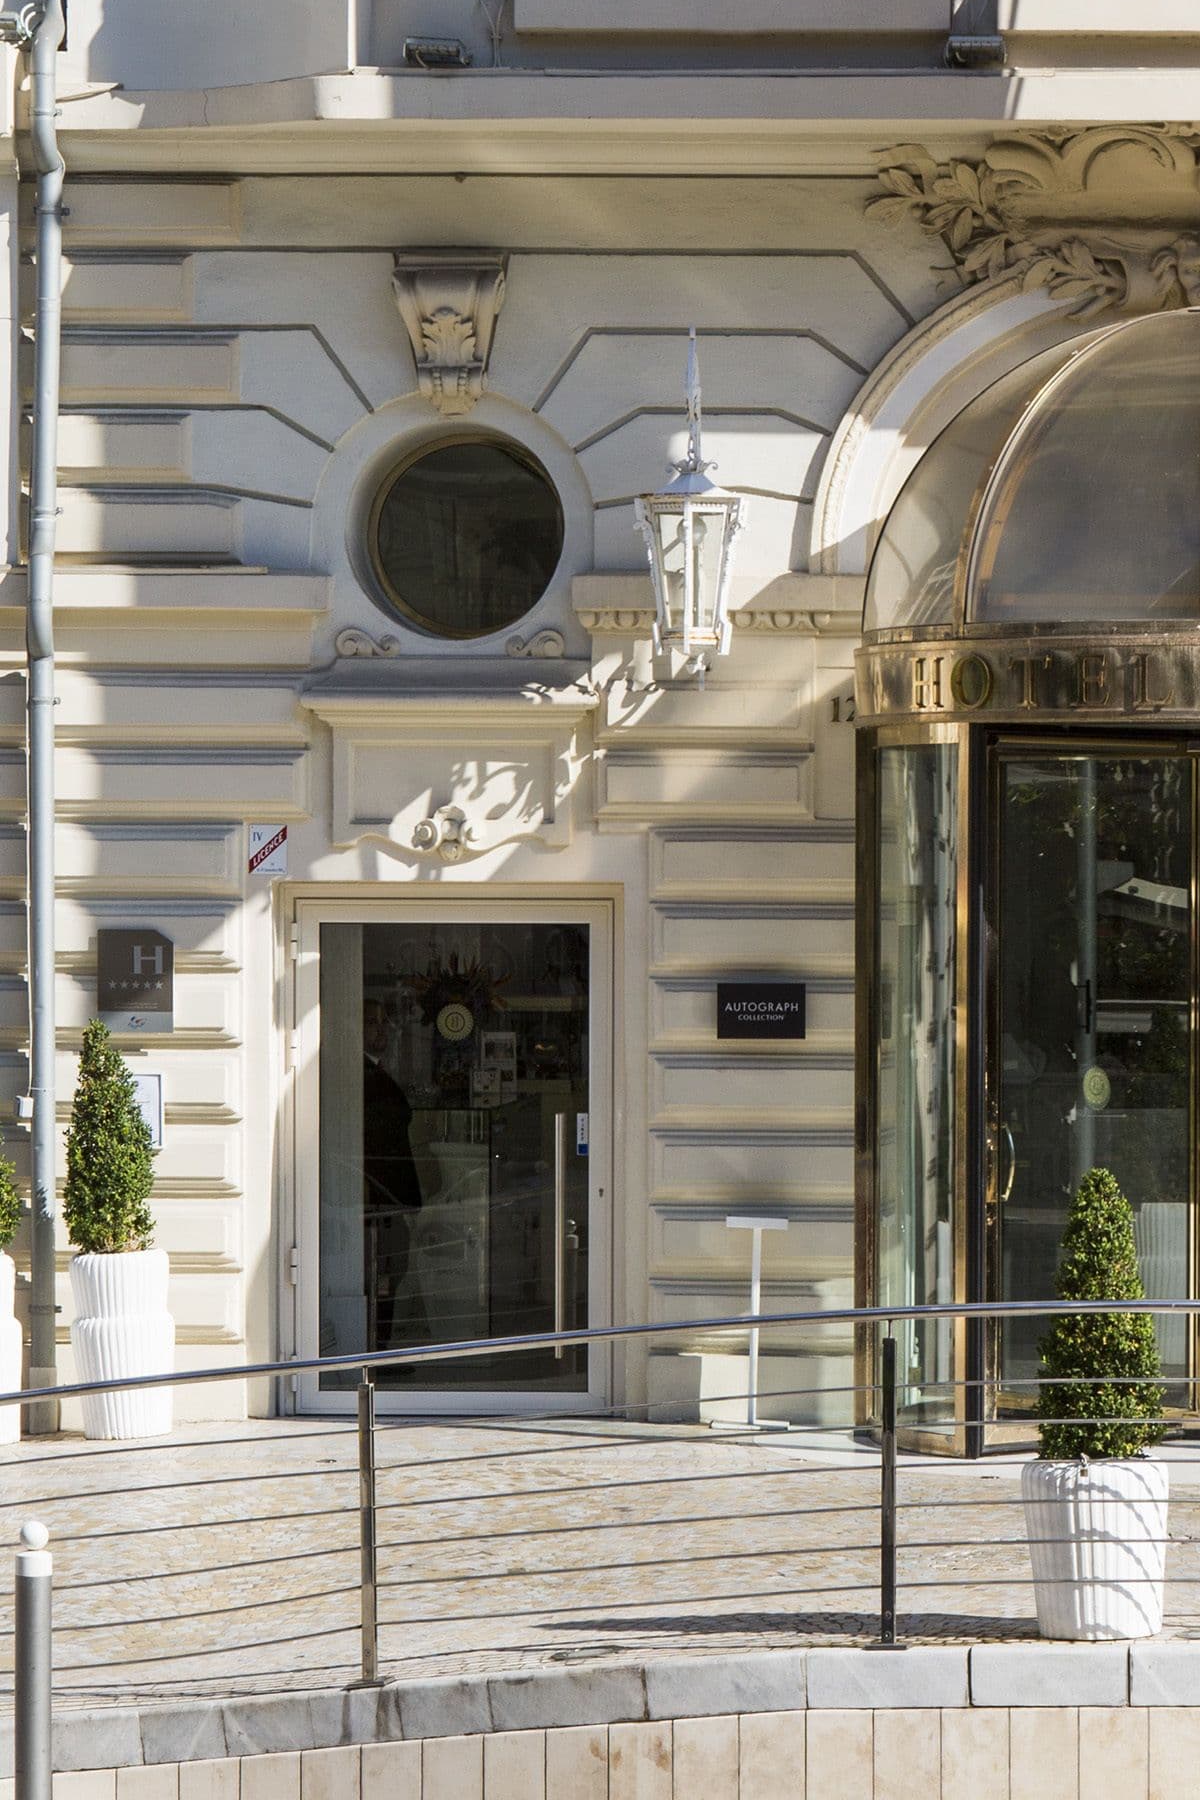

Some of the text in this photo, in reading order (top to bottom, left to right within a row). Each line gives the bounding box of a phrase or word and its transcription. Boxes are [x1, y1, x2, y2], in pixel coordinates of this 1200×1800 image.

[909, 653, 1175, 712] HOTEL
[252, 831, 264, 842] IV
[252, 830, 284, 867] LICENCE
[133, 945, 164, 975] H
[724, 1002, 800, 1013] AUTOGRAPH
